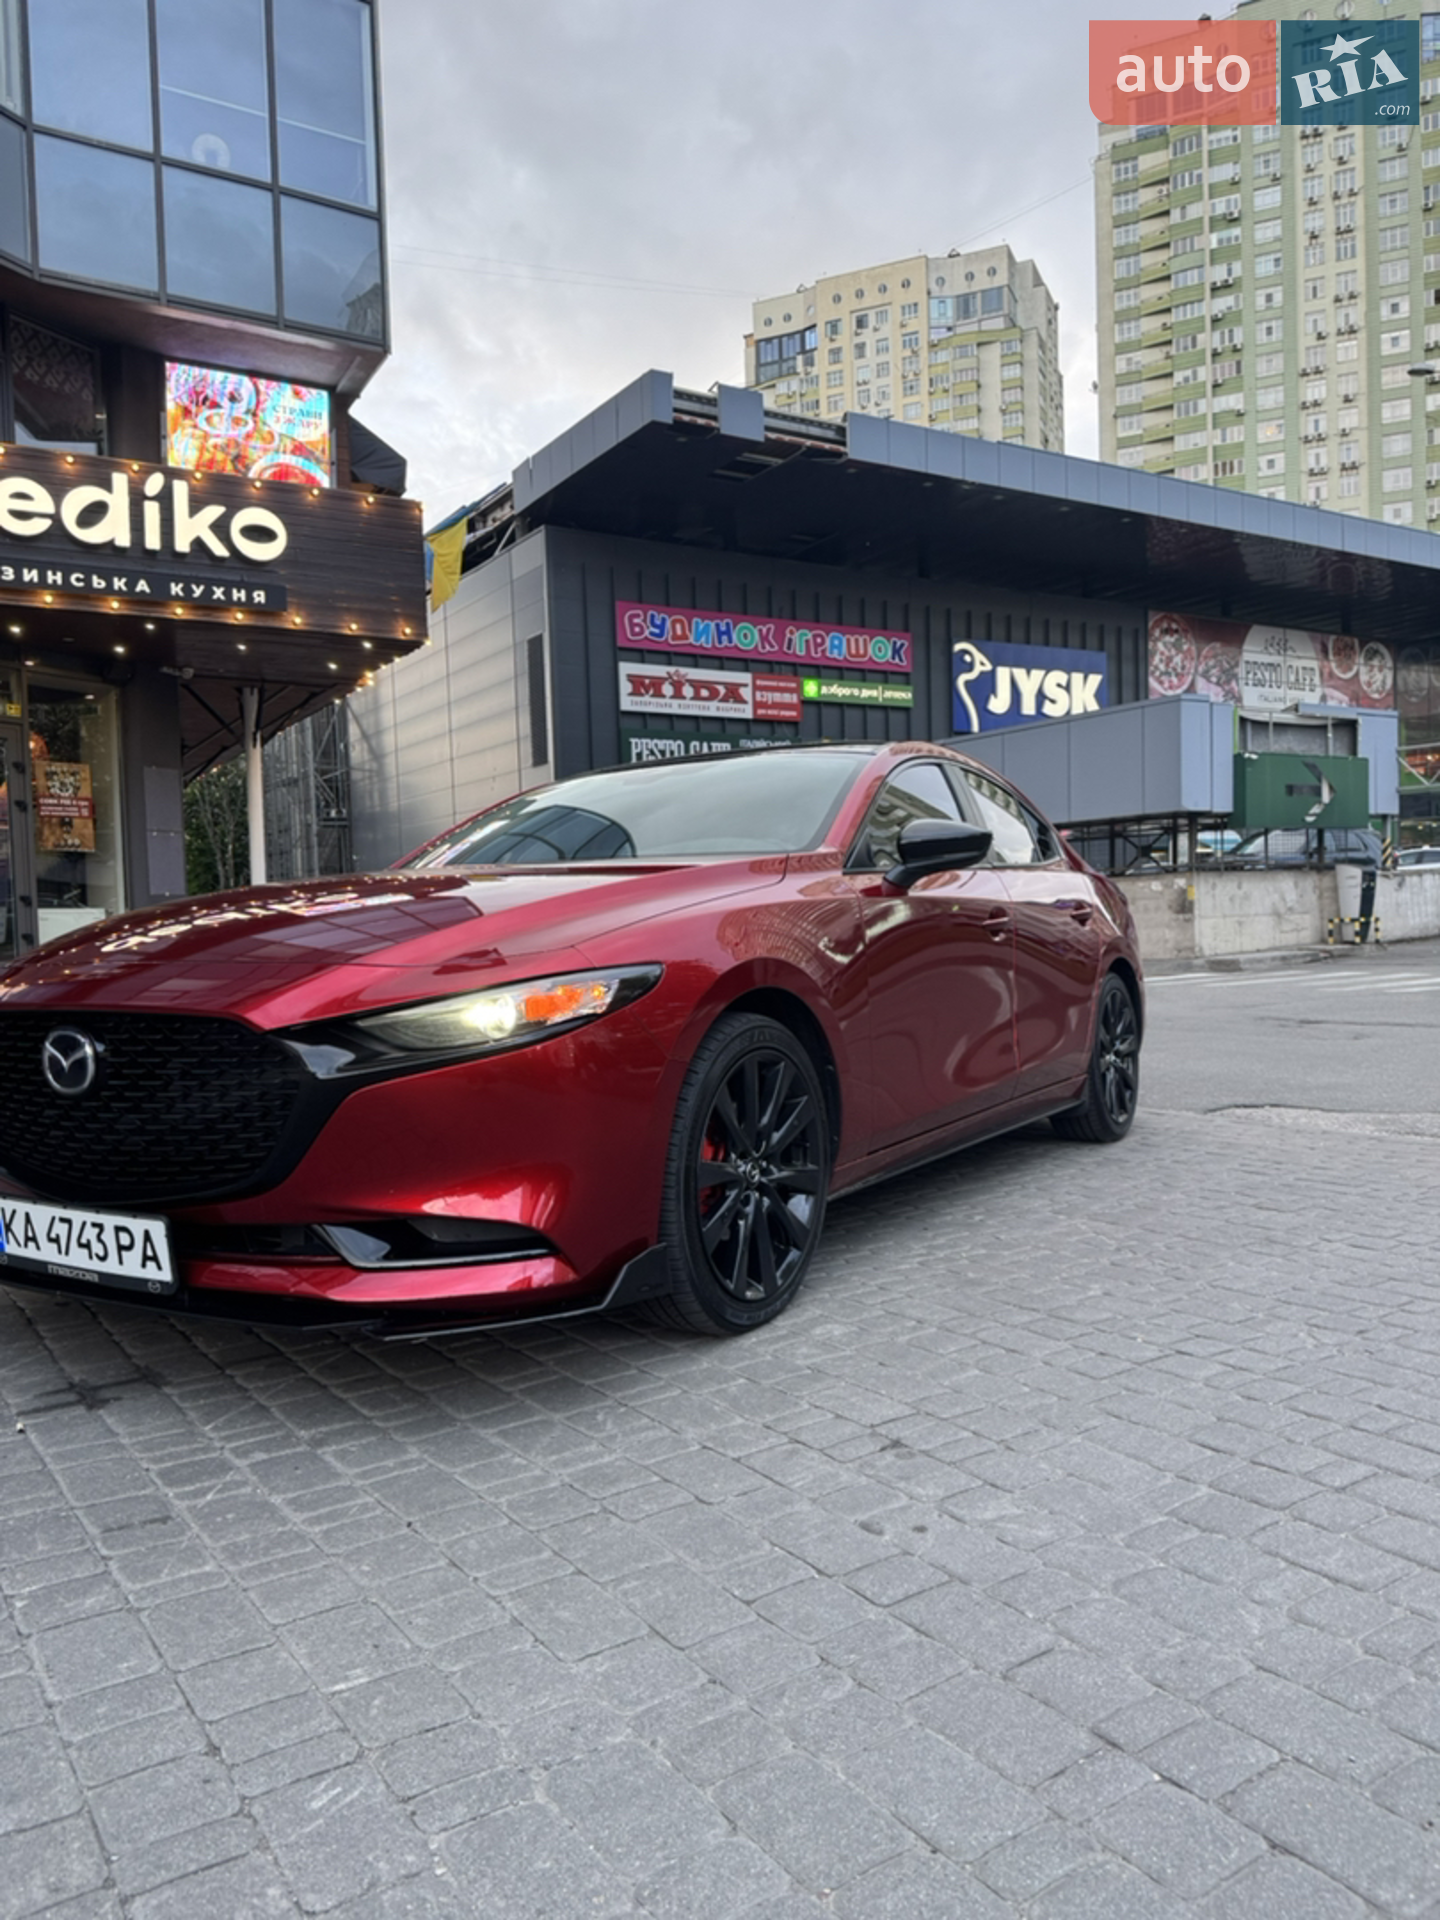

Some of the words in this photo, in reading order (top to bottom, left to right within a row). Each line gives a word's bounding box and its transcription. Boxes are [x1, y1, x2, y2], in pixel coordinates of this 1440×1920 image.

[272, 404, 323, 420] СТРАВИ
[1, 566, 150, 593] ЗИНСЬКА
[170, 582, 266, 604] КУХНЯ
[624, 609, 778, 653] БУДИНОК
[987, 666, 1103, 717] JYSK
[1244, 660, 1282, 689] PESTO
[1287, 664, 1316, 692] CAFE
[46, 1215, 109, 1262] 4743
